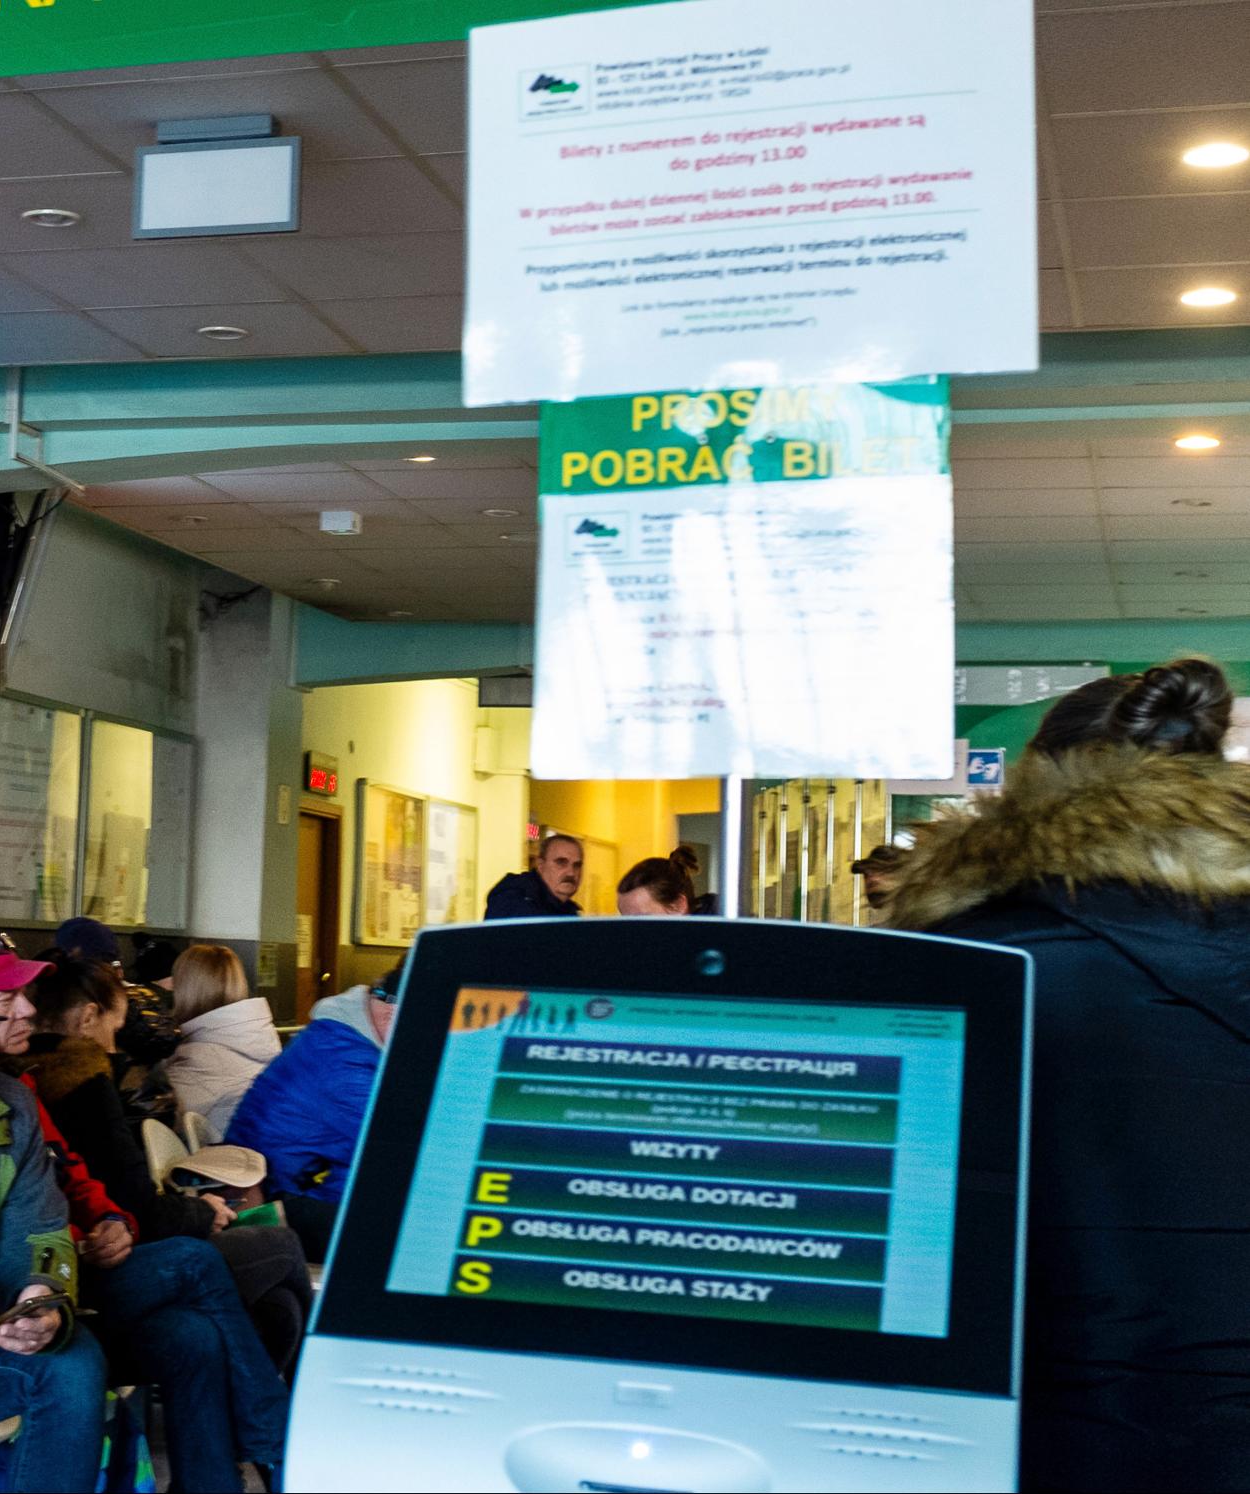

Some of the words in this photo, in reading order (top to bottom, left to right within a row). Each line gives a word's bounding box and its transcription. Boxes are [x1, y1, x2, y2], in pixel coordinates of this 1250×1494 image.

[559, 144, 603, 159] Bilety
[608, 146, 615, 154] z
[619, 136, 696, 153] numerem
[701, 130, 721, 145] do
[726, 123, 806, 142] rejestracji
[811, 115, 902, 134] wydawane
[909, 114, 925, 127] są
[670, 156, 689, 170] do
[695, 152, 756, 171] godziny
[762, 145, 807, 162] 13.00
[520, 208, 532, 218] W
[789, 182, 806, 193] do
[812, 174, 883, 192] rejestracji
[888, 168, 972, 186] wydawanie
[605, 219, 639, 230] może
[787, 200, 826, 216] przed
[800, 236, 864, 253] rejestracji
[856, 255, 872, 266] do
[631, 387, 837, 432] PROSIMY
[561, 433, 753, 488] POBRAĆ
[783, 437, 920, 478] BILET
[527, 1043, 690, 1069] REJESTRACJA
[695, 1054, 704, 1070] /
[630, 1141, 721, 1160] WIZYTY
[476, 1171, 513, 1205] E
[568, 1178, 686, 1203] OBSŁUGA
[690, 1186, 797, 1210] DOTACJI
[466, 1216, 504, 1247] P
[511, 1219, 631, 1245] OBSŁUGA
[635, 1228, 842, 1260] PRACODAWCÓW
[455, 1261, 493, 1294] S
[563, 1270, 686, 1296] OBSŁUGA
[692, 1278, 773, 1303] STAŻY
